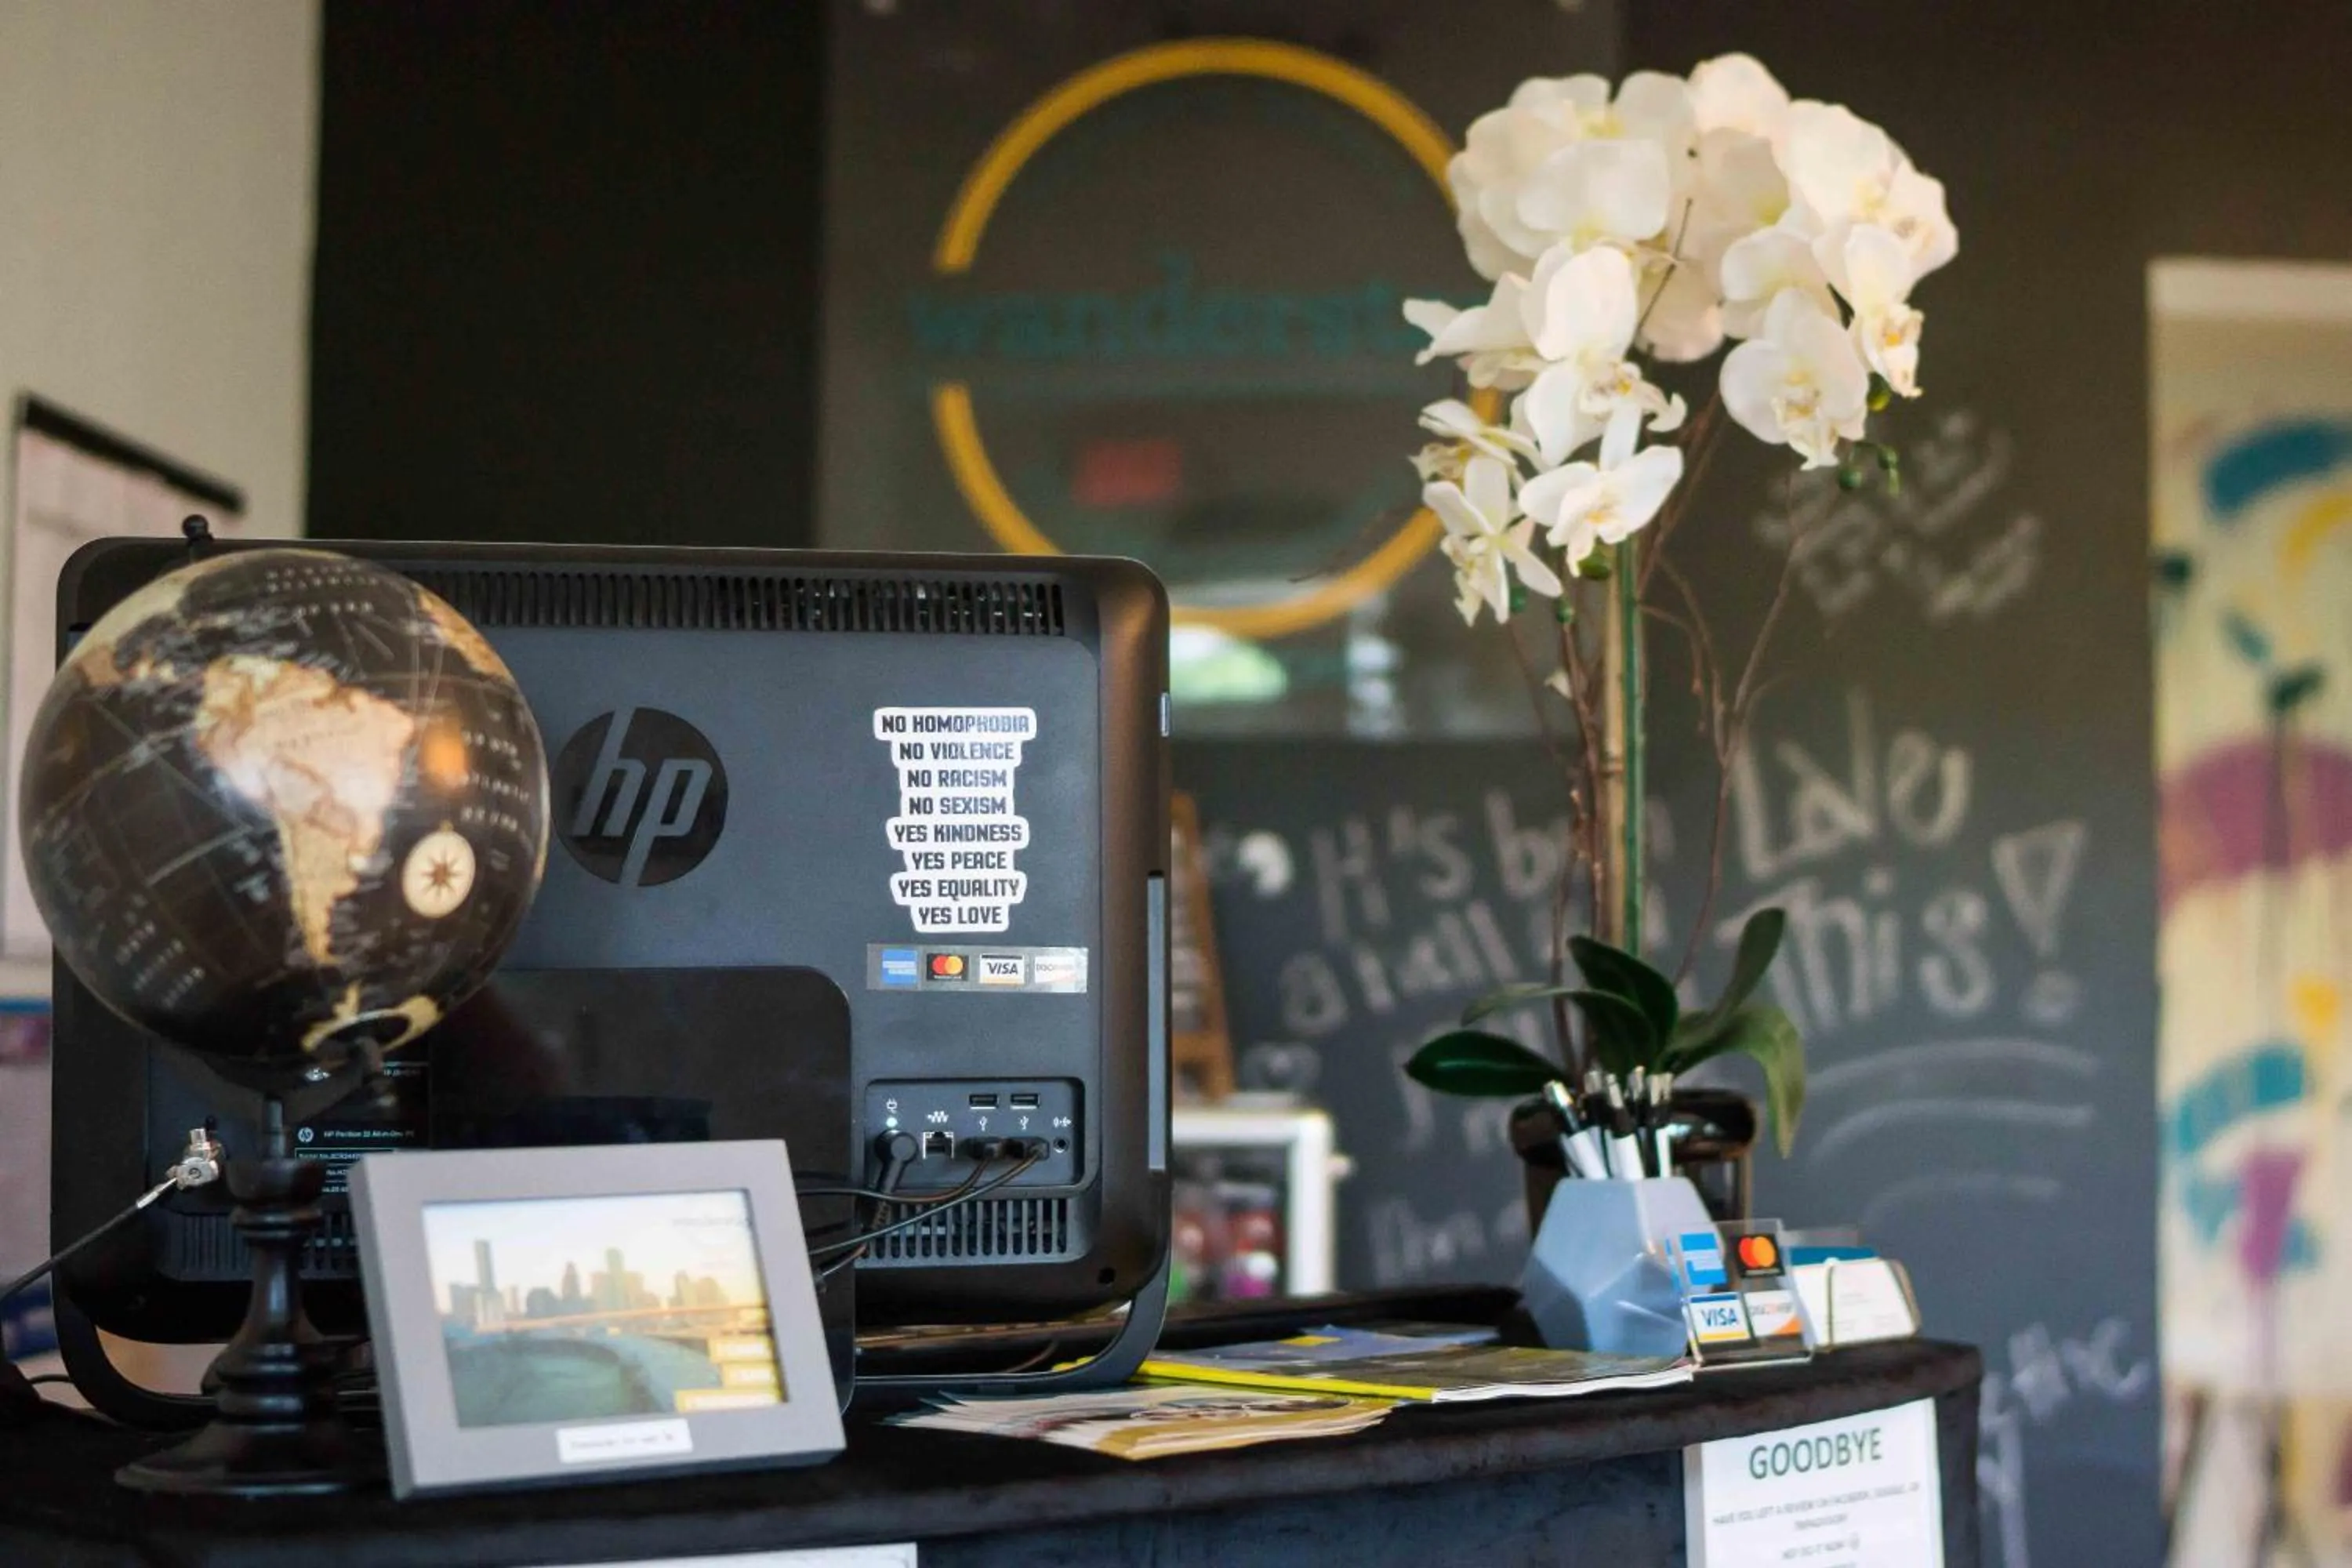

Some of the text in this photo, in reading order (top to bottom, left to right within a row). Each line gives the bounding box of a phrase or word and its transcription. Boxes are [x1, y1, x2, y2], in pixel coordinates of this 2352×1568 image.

[882, 714, 1029, 733] NO HOMOPHOBIA
[899, 742, 1014, 760] NO VIOLENCE
[907, 769, 1007, 787] NO RACISM
[568, 707, 713, 887] hp
[909, 797, 1007, 815] NO SEXISM
[895, 824, 1022, 843] YES KINDNESS
[912, 851, 1007, 869] YES PEACE
[898, 879, 1019, 902] YES EQUALITY
[918, 906, 1002, 925] YES LOVE
[987, 962, 1018, 975] VISA
[1700, 1308, 1738, 1327] VISA
[1749, 1428, 1882, 1479] GOODBYE
